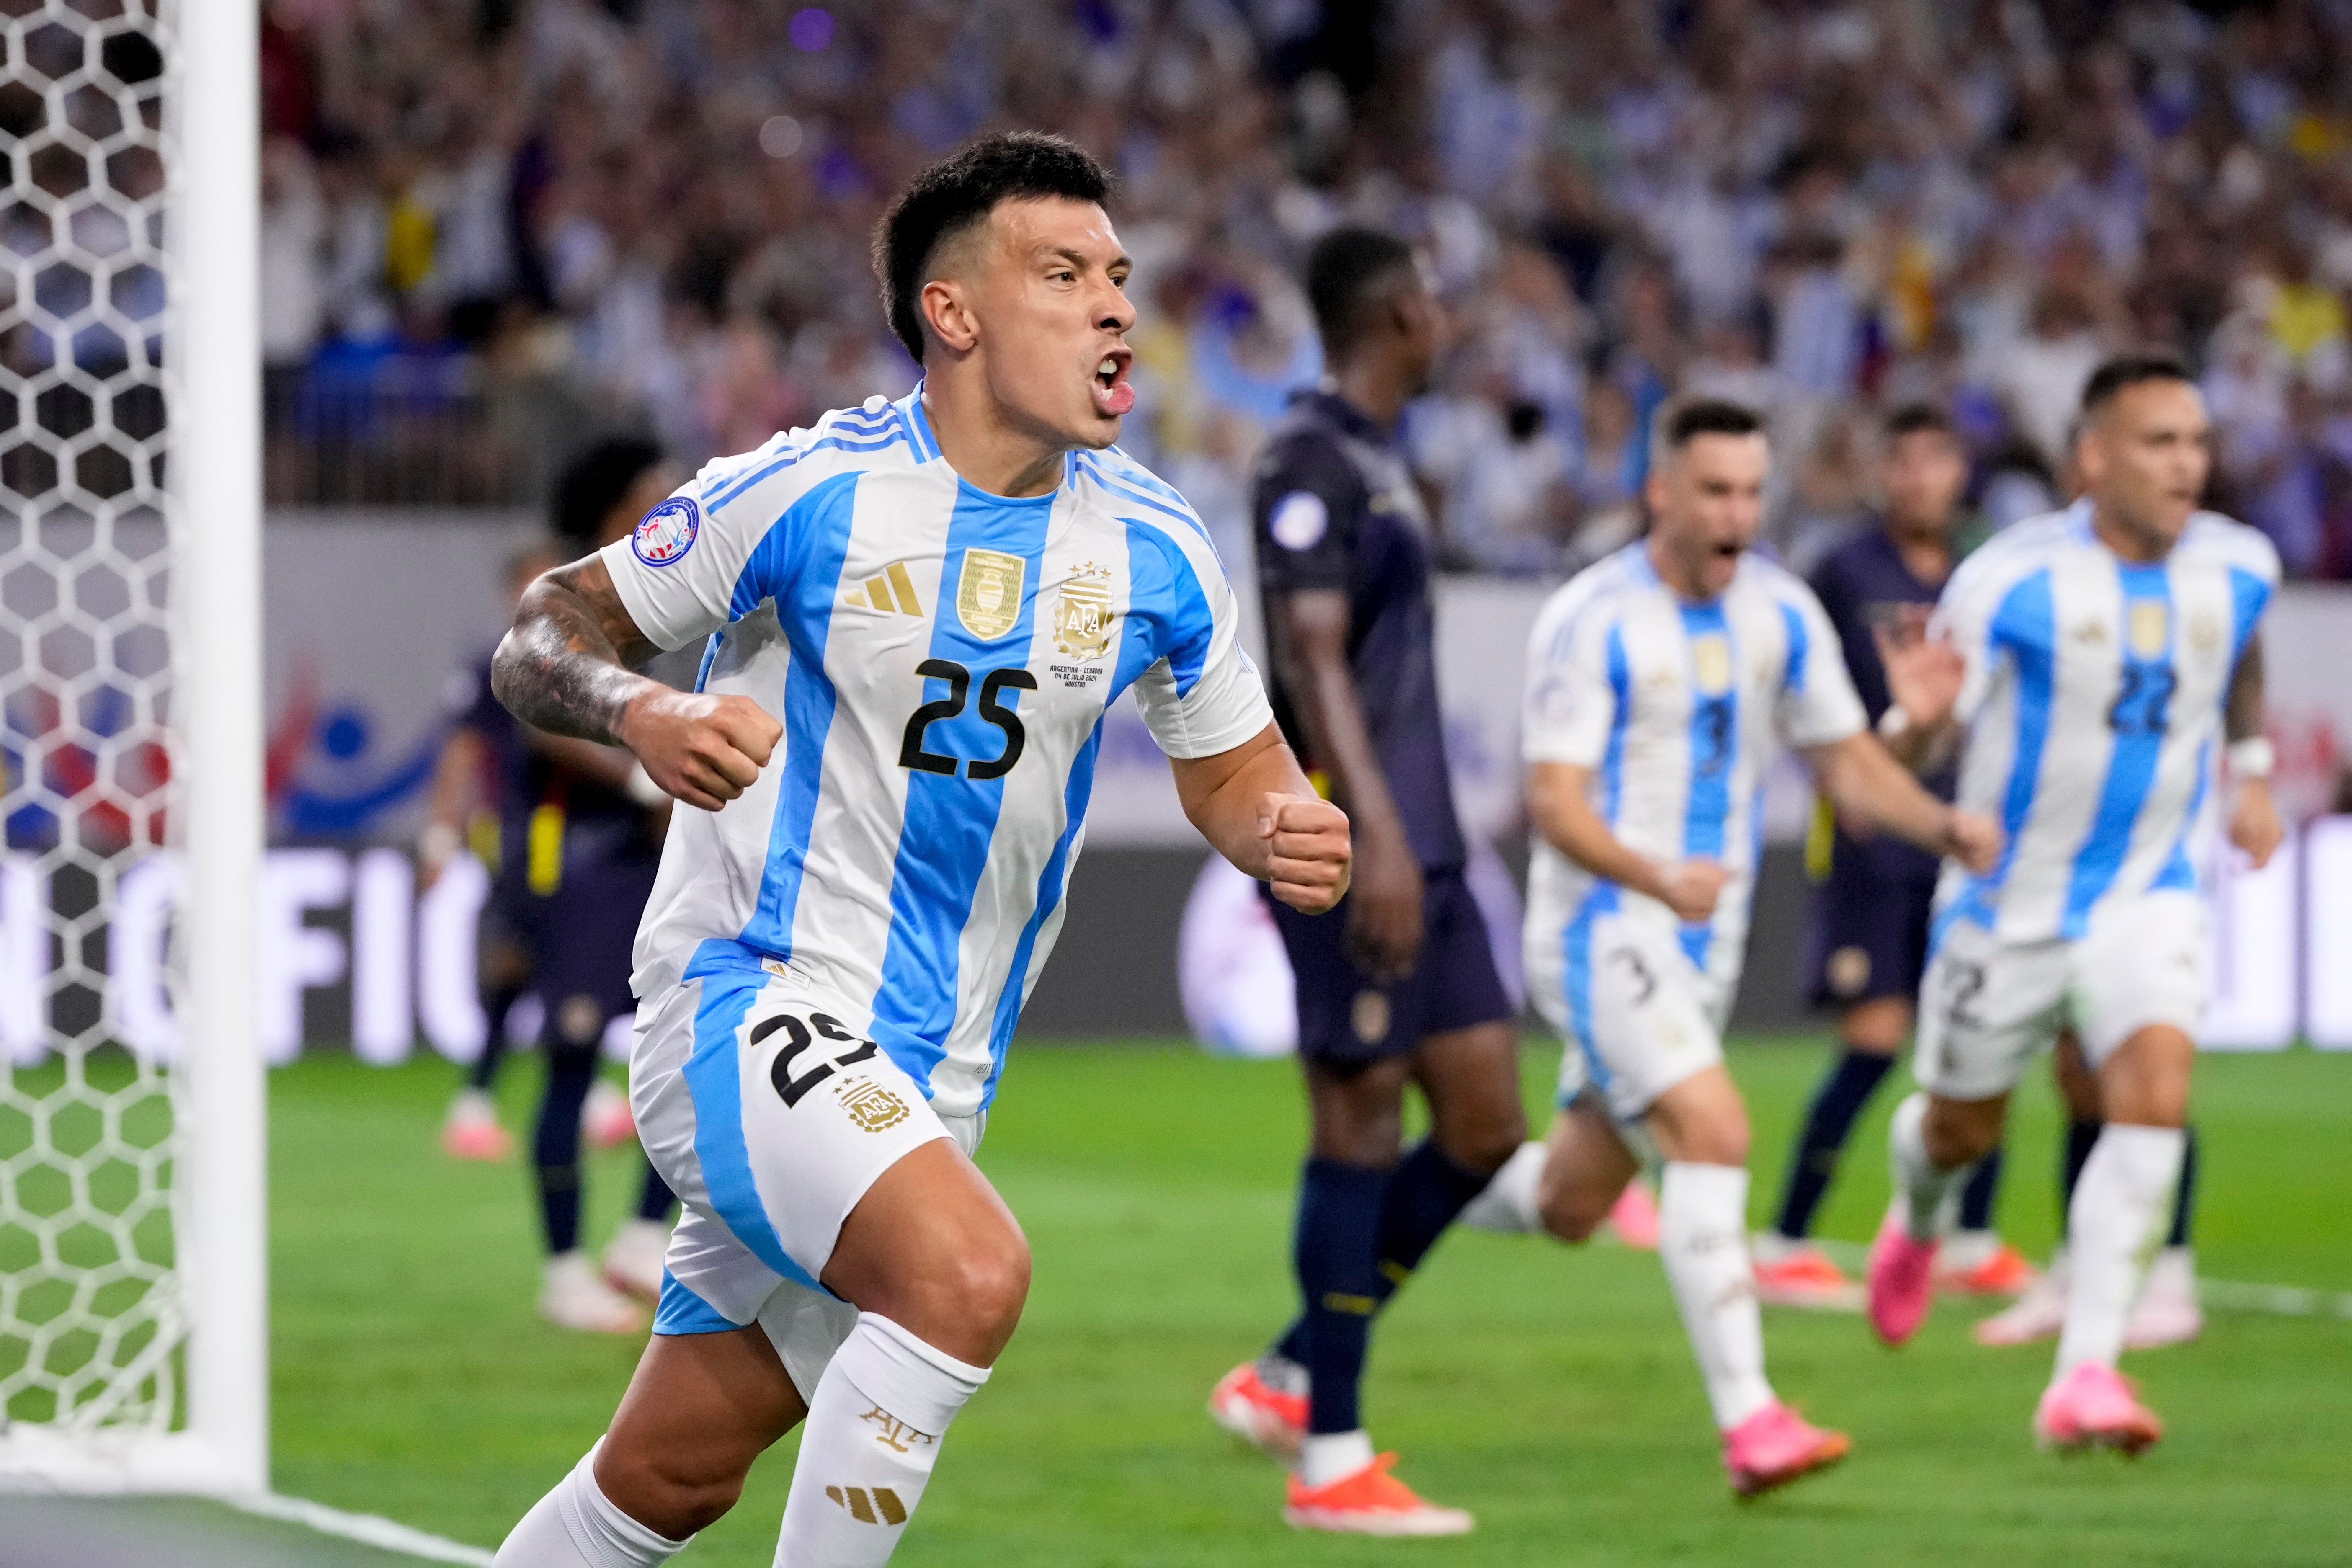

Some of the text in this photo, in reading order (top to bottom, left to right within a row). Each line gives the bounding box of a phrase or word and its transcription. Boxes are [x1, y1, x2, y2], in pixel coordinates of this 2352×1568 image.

[1065, 600, 1101, 639] AFA
[898, 658, 1038, 779] 25
[2102, 662, 2178, 730] 22
[1607, 943, 1657, 1006] 3
[750, 1012, 877, 1109] 25
[856, 1093, 895, 1120] AFA
